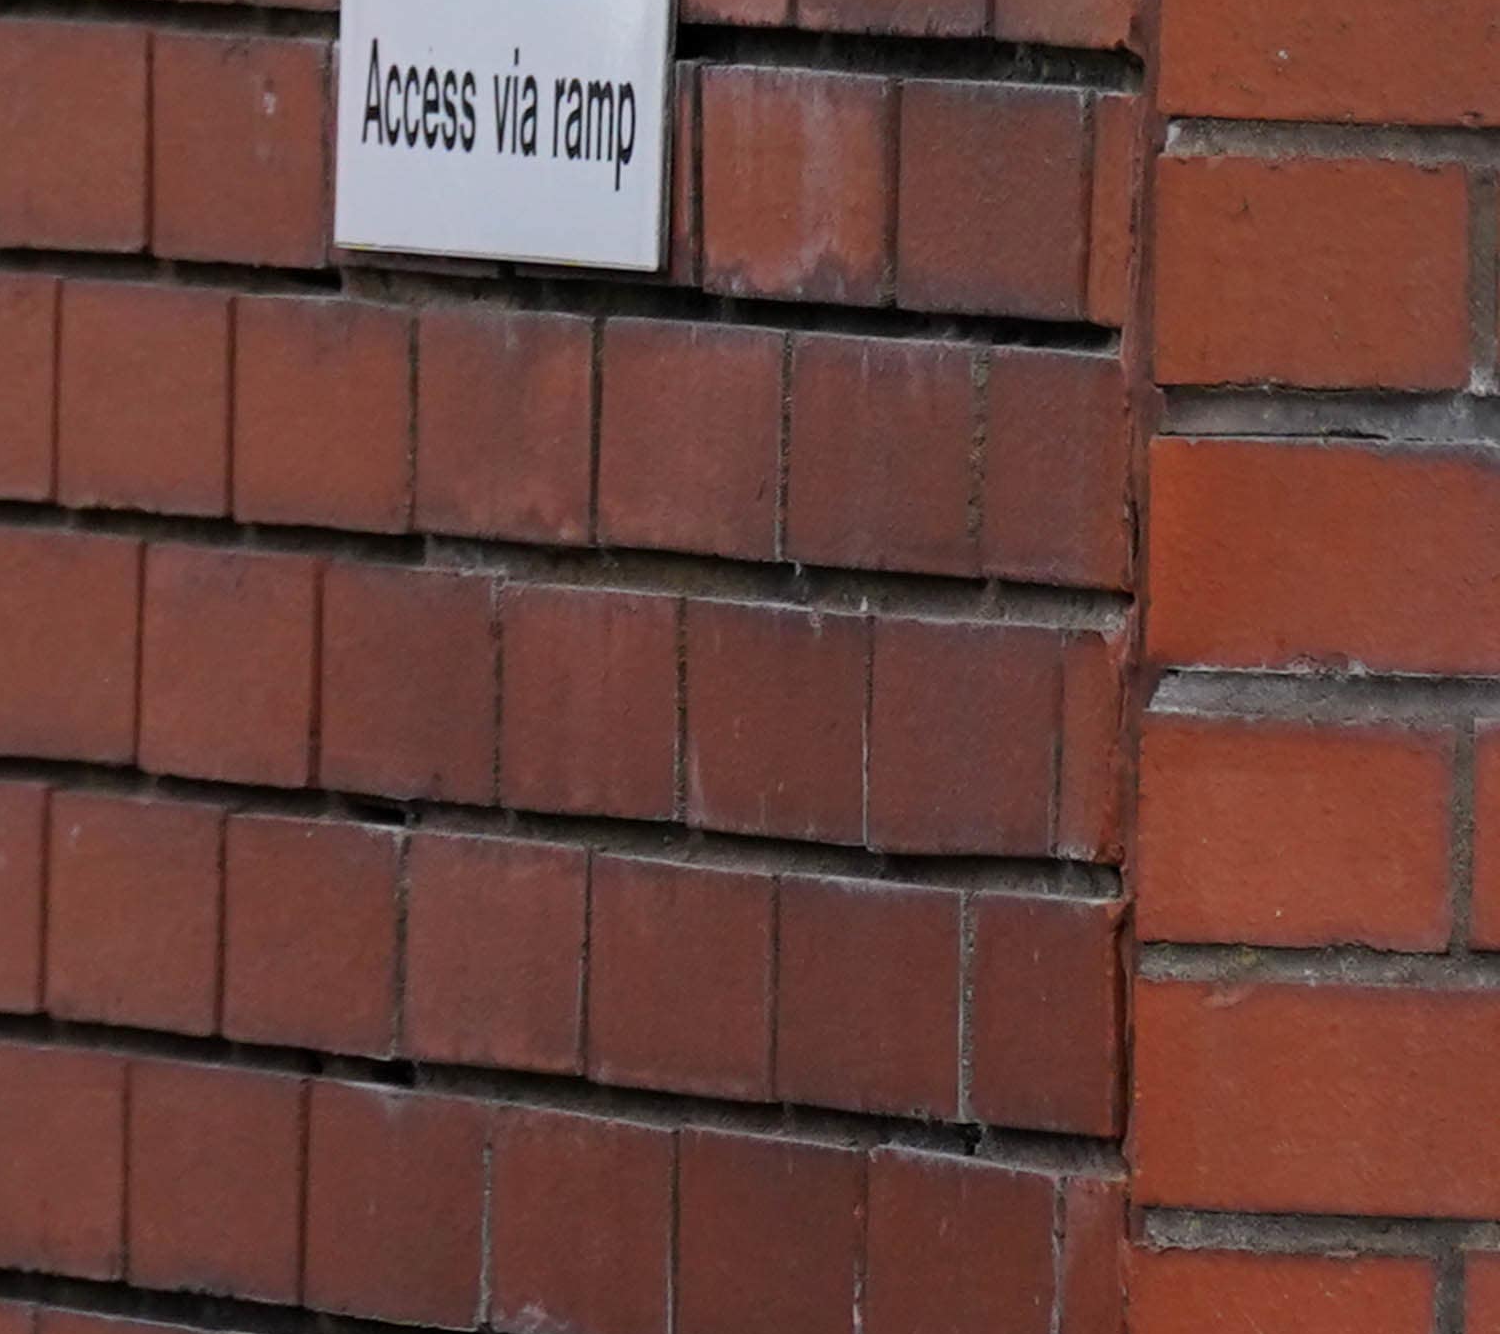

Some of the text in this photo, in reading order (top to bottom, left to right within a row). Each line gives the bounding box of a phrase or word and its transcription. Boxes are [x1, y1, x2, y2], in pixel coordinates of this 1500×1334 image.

[361, 37, 636, 192] Access via ramp
